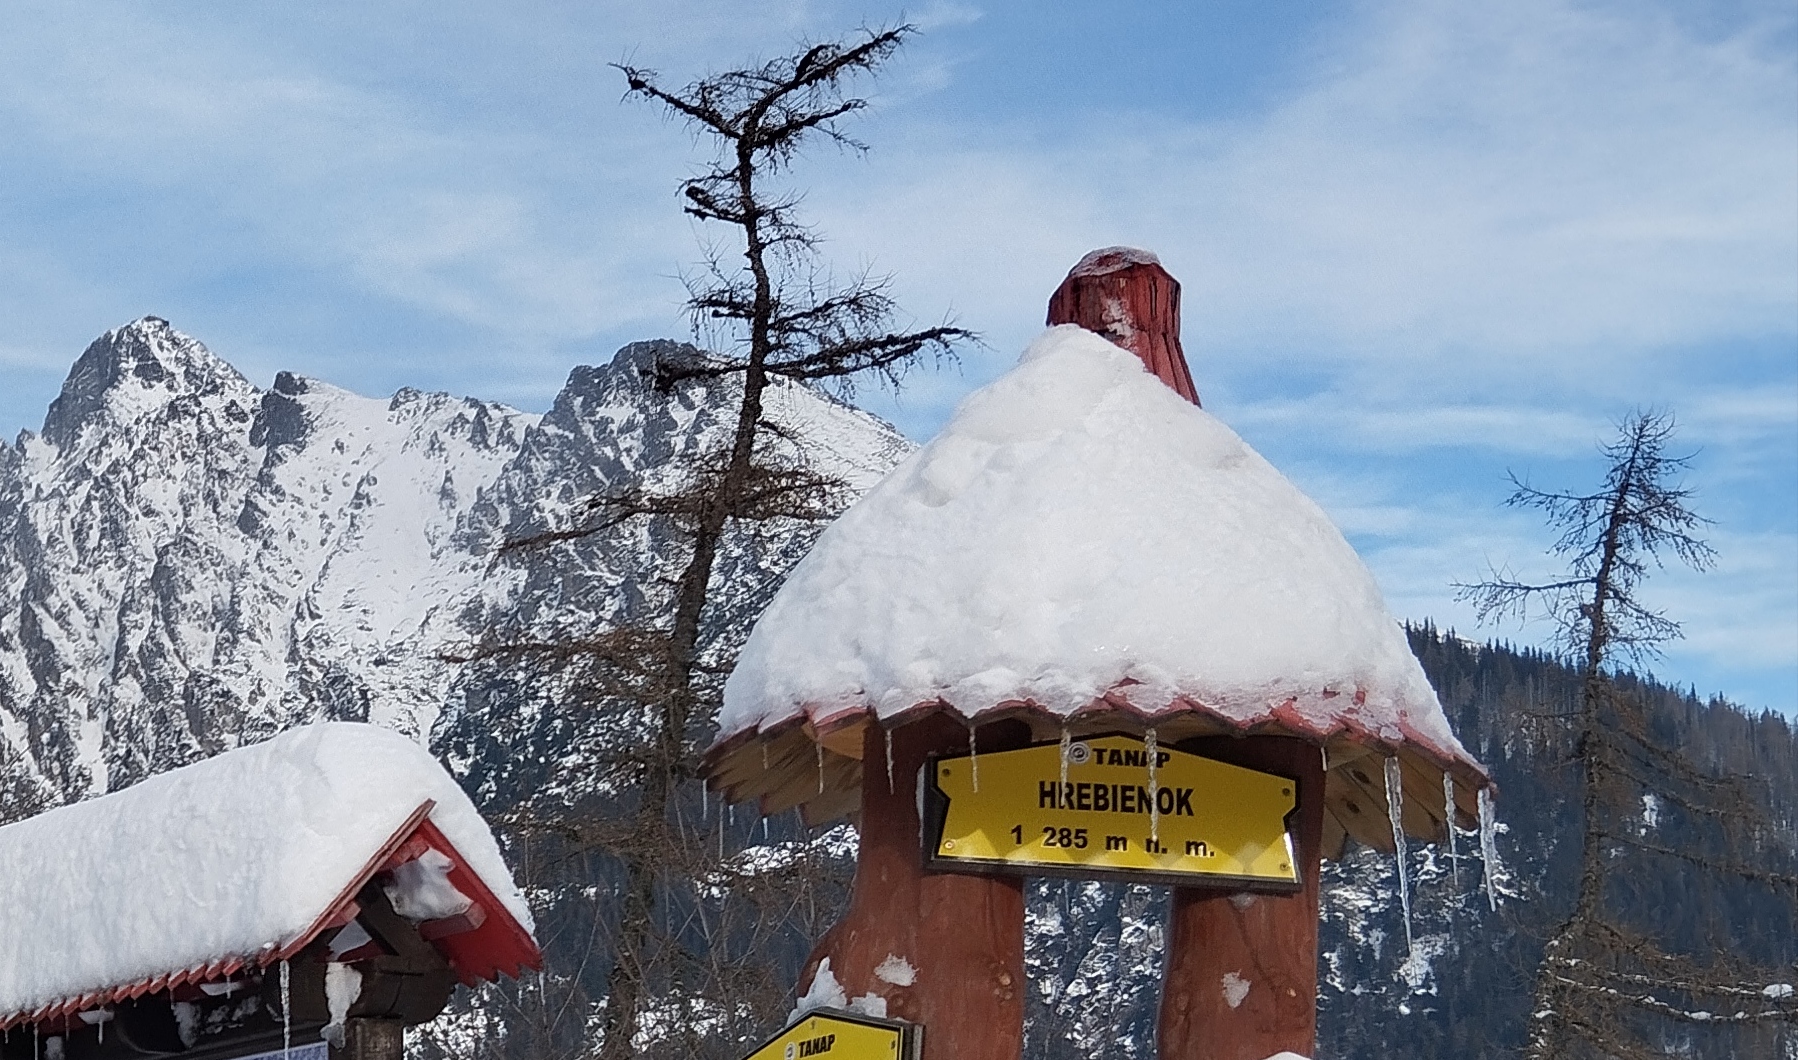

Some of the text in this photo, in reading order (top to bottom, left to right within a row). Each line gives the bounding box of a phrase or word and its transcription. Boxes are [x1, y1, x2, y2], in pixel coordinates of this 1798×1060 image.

[1038, 779, 1195, 817] HREBIENOK
[1011, 825, 1215, 858] 1 285 m n. m.
[798, 1034, 836, 1058] TANAP
